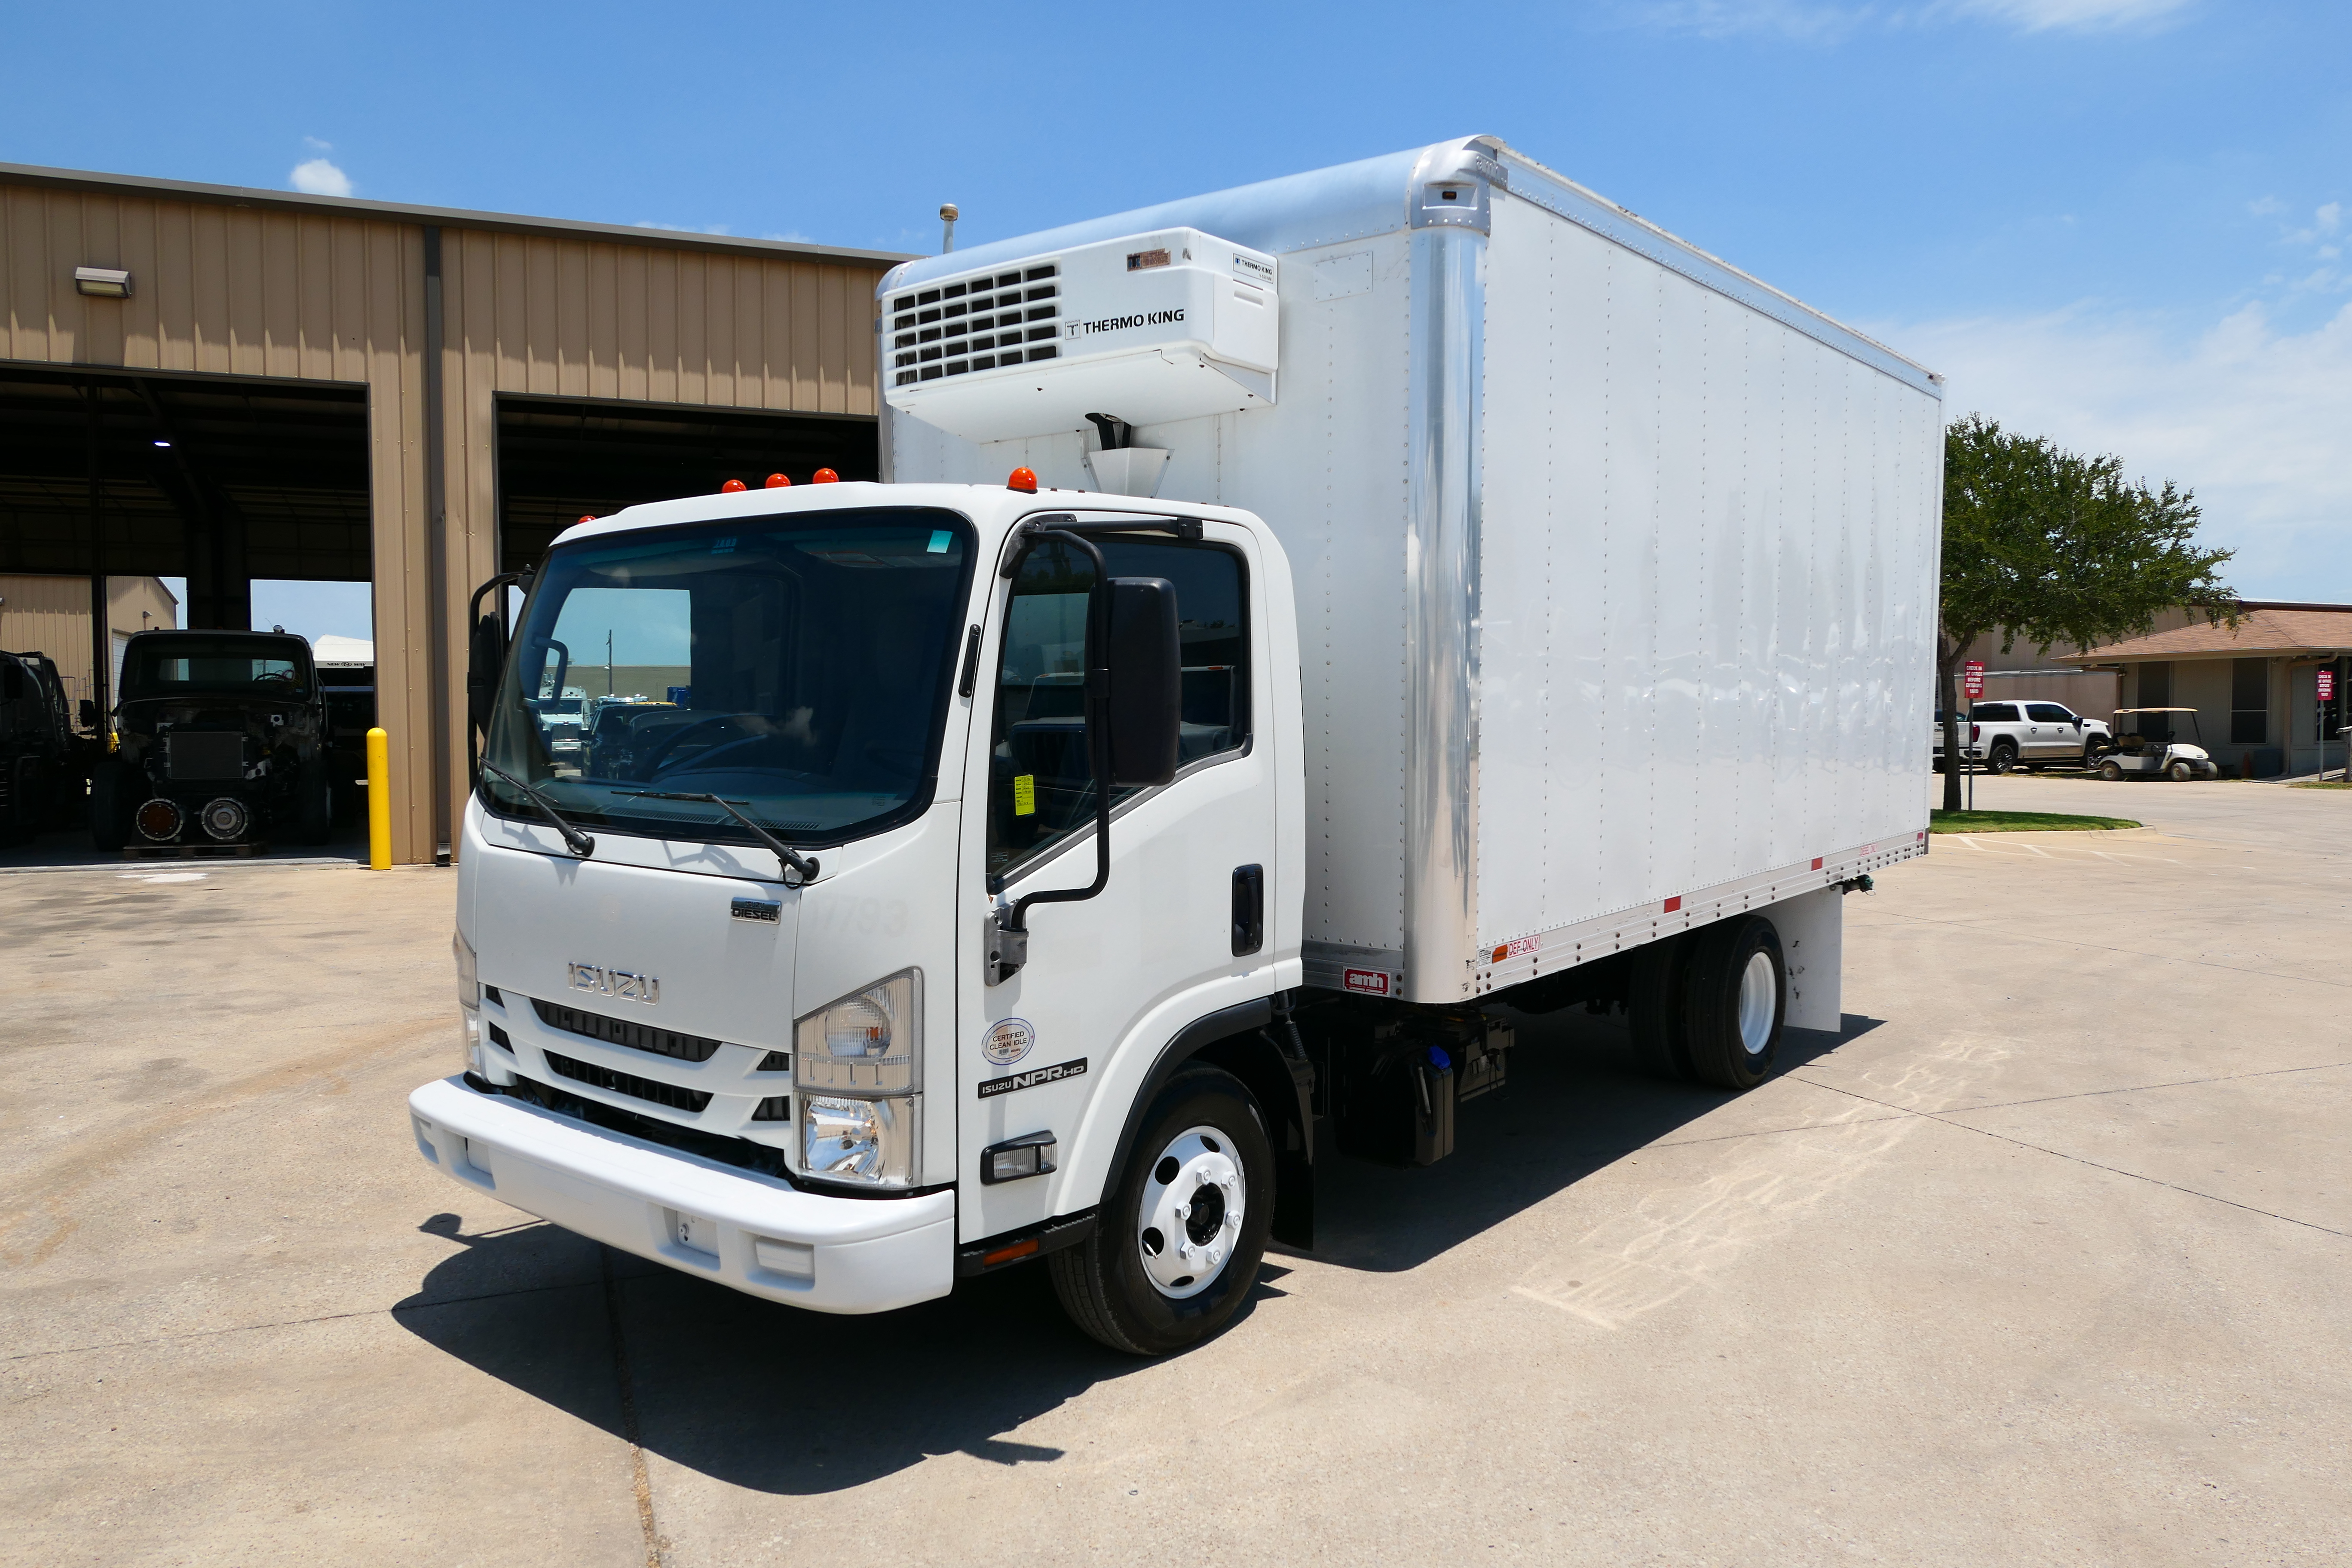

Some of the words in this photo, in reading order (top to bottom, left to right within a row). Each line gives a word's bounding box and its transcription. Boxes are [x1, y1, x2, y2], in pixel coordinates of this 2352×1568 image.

[1241, 260, 1261, 271] THERMO
[1262, 266, 1272, 275] KING
[1083, 315, 1144, 334] THERMO
[1148, 309, 1184, 325] KING
[732, 907, 776, 921] DIESEL
[1509, 941, 1521, 956] DEF
[1523, 936, 1538, 952] ONLY
[568, 961, 660, 1006] ISUZU
[1349, 973, 1383, 988] amh
[993, 1031, 1024, 1042] CERTIFIED
[990, 1041, 1011, 1050] CLEAN
[982, 1081, 1011, 1094] ISUZU
[1013, 1066, 1064, 1089] NPR
[1064, 1065, 1084, 1077] HD
